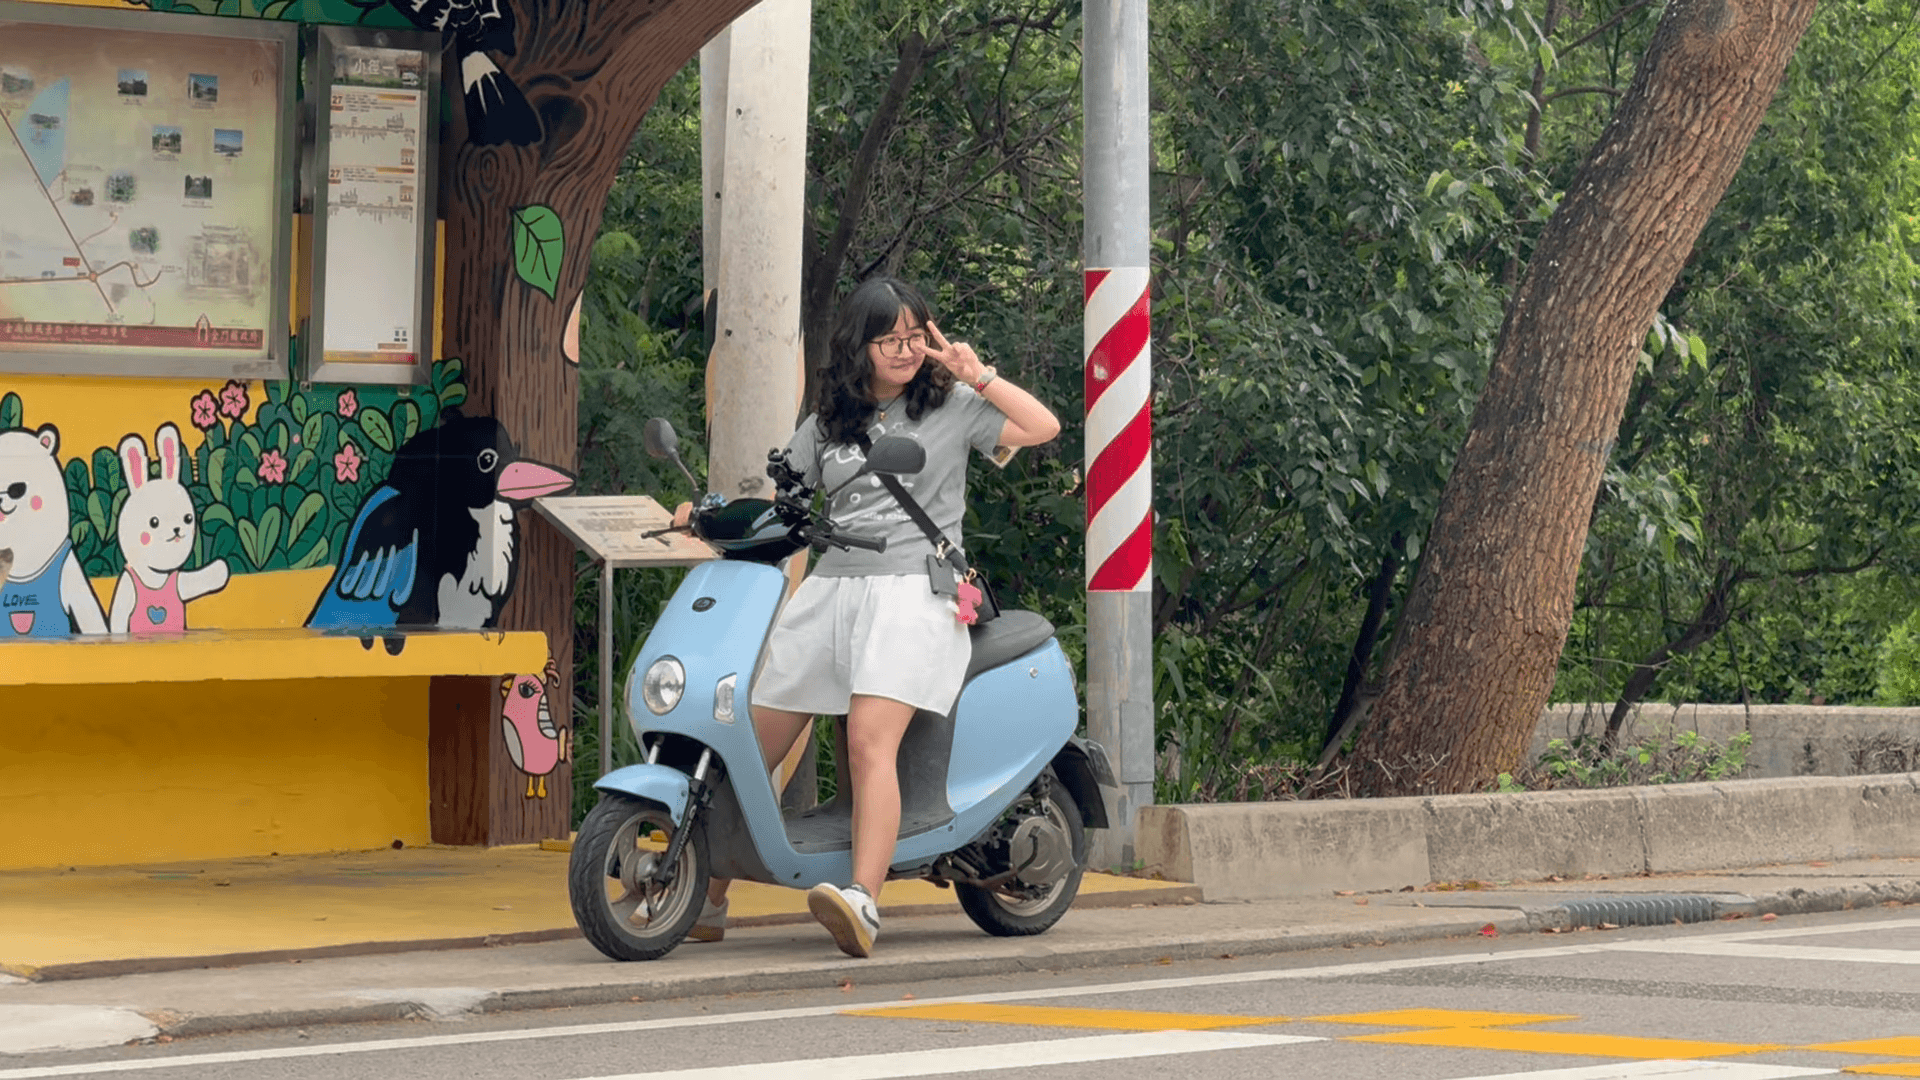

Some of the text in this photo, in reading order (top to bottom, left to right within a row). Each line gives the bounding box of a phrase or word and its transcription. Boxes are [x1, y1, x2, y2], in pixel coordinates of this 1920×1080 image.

[332, 95, 343, 104] 27
[330, 169, 341, 178] 27
[3, 593, 40, 607] LOVE
